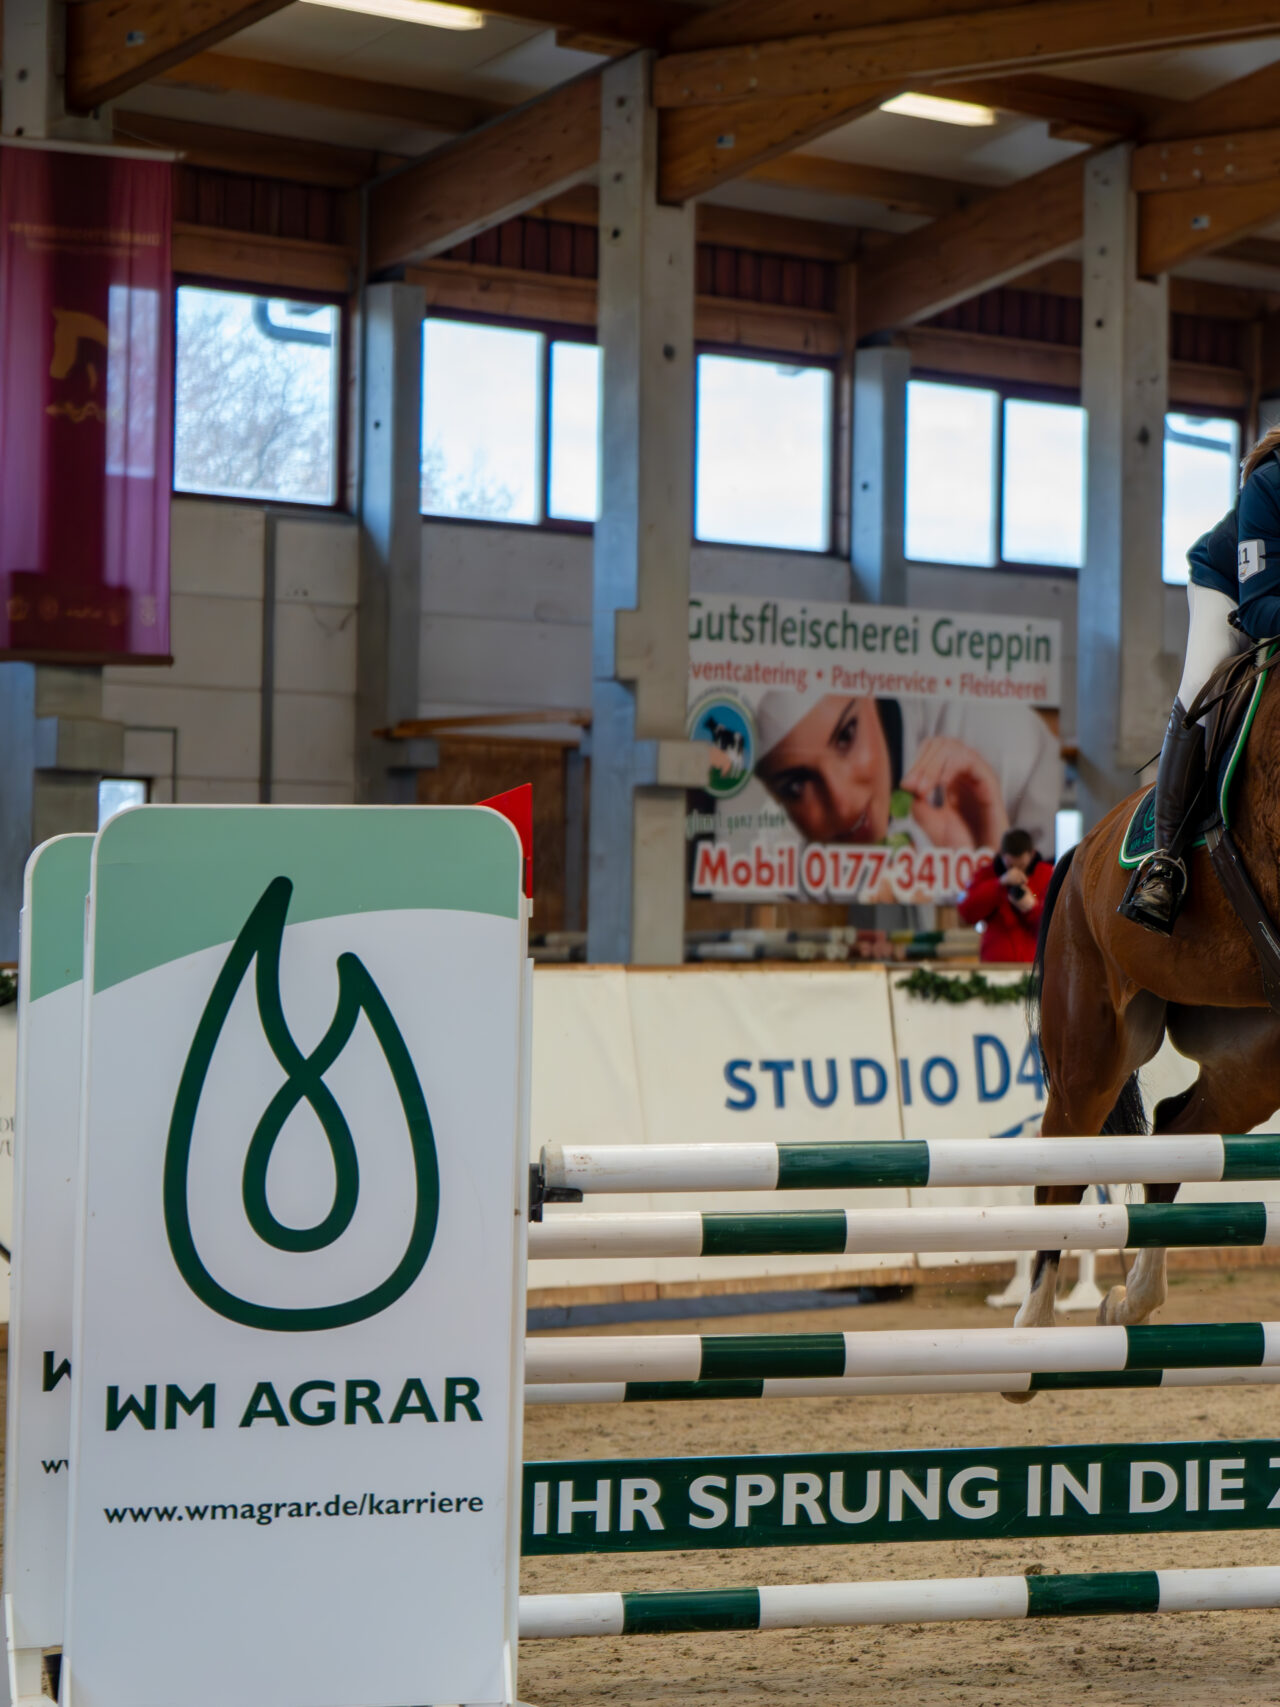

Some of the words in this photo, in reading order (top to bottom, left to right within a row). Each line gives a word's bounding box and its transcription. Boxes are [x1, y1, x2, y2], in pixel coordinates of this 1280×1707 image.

[689, 600, 918, 654] Gutsfleischerei
[932, 617, 1051, 673] Greppin
[688, 659, 808, 694] ventcatering
[831, 665, 938, 697] Partyservice
[959, 672, 1048, 700] Fleischerei
[698, 845, 795, 888] Mobil
[805, 850, 887, 889] 0177
[724, 1056, 959, 1111] STUDIO
[973, 1033, 1044, 1102] D4
[105, 1383, 217, 1431] WM
[239, 1376, 484, 1428] AGRAR
[104, 1491, 484, 1526] www.wmagrar.de/karriere
[532, 1477, 665, 1535] IHR
[688, 1465, 999, 1530] SPRUNG
[1026, 1462, 1102, 1517] IN
[1128, 1458, 1247, 1514] DIE
